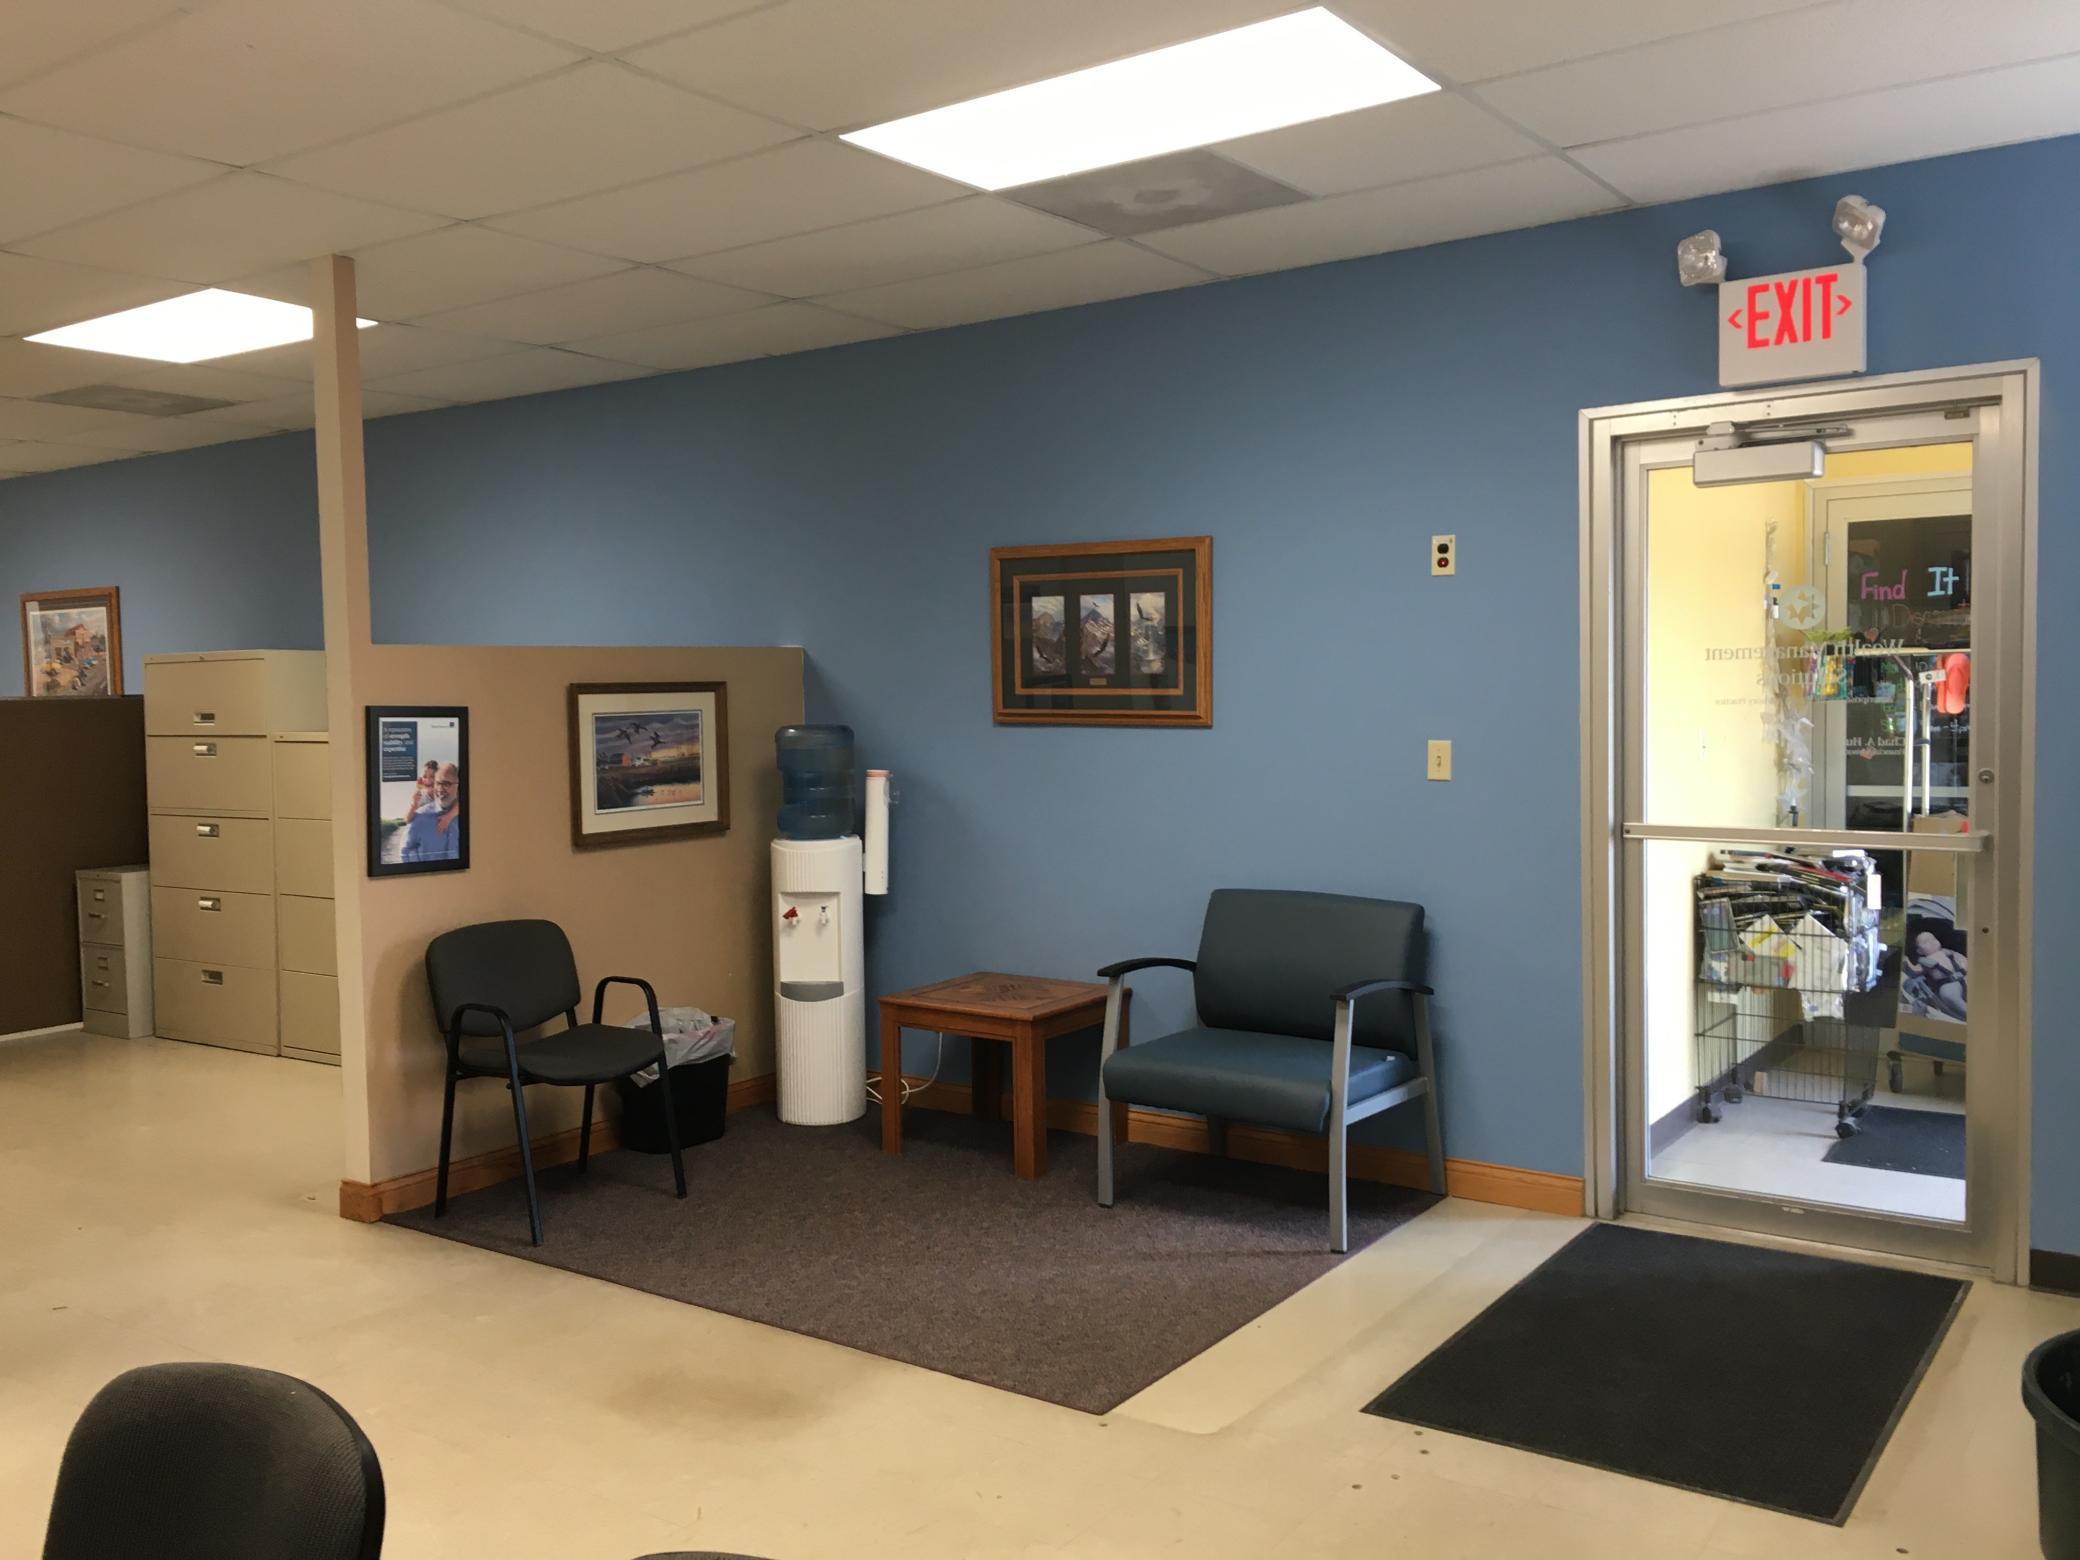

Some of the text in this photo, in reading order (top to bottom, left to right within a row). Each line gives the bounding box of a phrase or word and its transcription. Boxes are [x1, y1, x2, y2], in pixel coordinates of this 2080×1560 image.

[1747, 273, 1838, 349] EXIT
[1861, 566, 1960, 601] Find It
